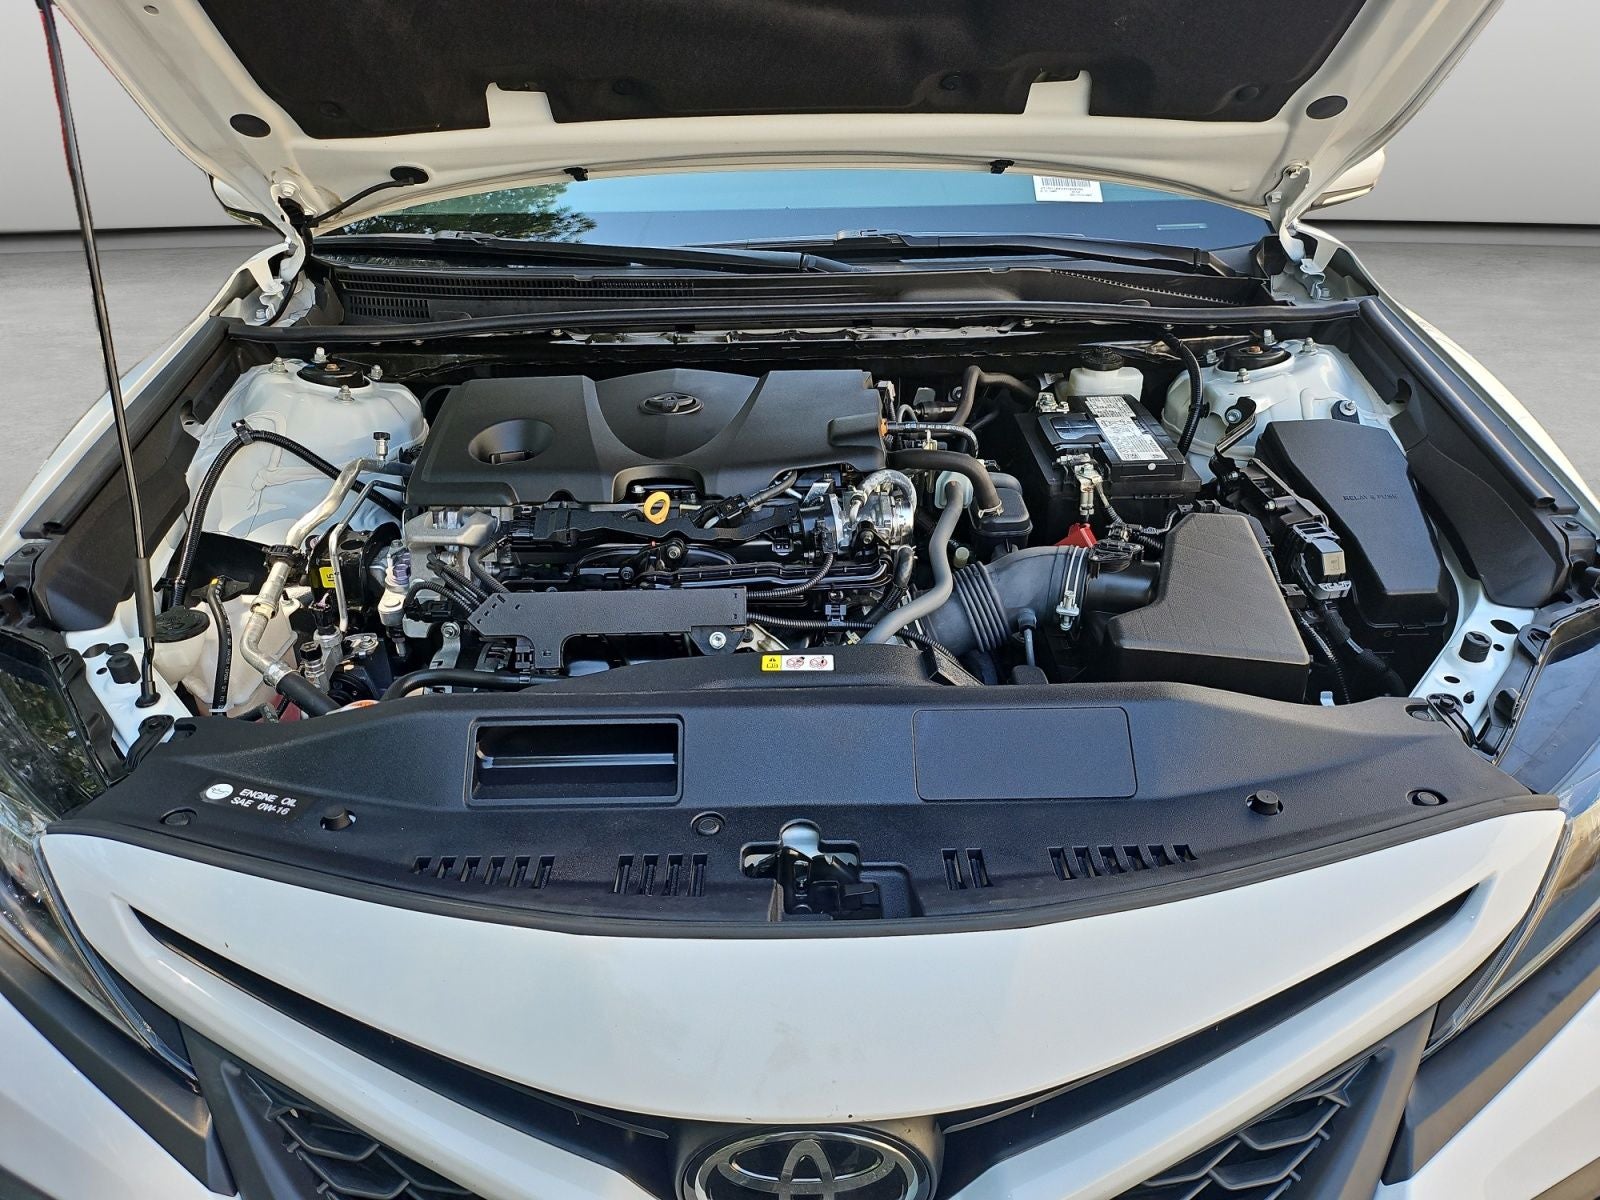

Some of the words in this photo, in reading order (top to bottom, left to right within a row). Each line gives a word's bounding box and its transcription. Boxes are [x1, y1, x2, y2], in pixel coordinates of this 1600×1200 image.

[230, 796, 254, 807] SAE
[256, 803, 291, 815] 0W-16
[239, 788, 279, 802] ENGINE
[280, 797, 297, 807] OIL
